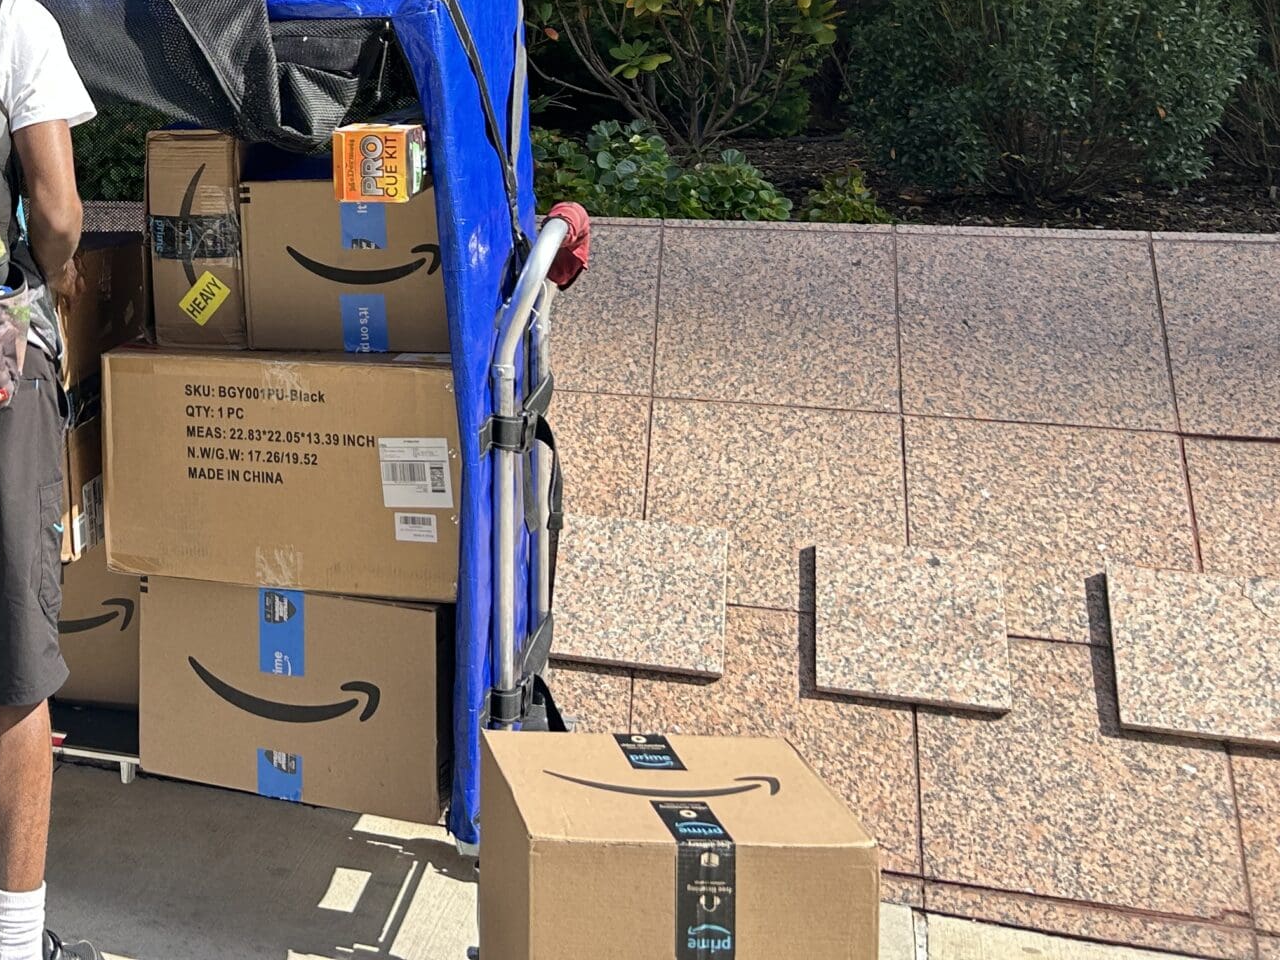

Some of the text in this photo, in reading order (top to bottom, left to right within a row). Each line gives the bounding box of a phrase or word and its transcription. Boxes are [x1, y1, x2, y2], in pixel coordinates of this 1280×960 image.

[360, 134, 385, 196] PRO
[384, 136, 398, 198] CUE KIT
[186, 277, 222, 319] HEAVY
[358, 307, 369, 325] It's
[360, 327, 370, 340] on
[185, 384, 325, 403] SKU: BGY001PU-Black
[186, 405, 244, 419] QTY: 1 PC
[186, 426, 226, 439] MEAS:
[343, 434, 375, 448] INCH
[187, 446, 318, 466] N.W/G.W: 17.26/19.52
[188, 467, 283, 484] MADE IN CHINA
[272, 651, 283, 674] ime
[629, 753, 671, 762] prime
[678, 827, 724, 837] prime
[687, 937, 732, 954] prime
